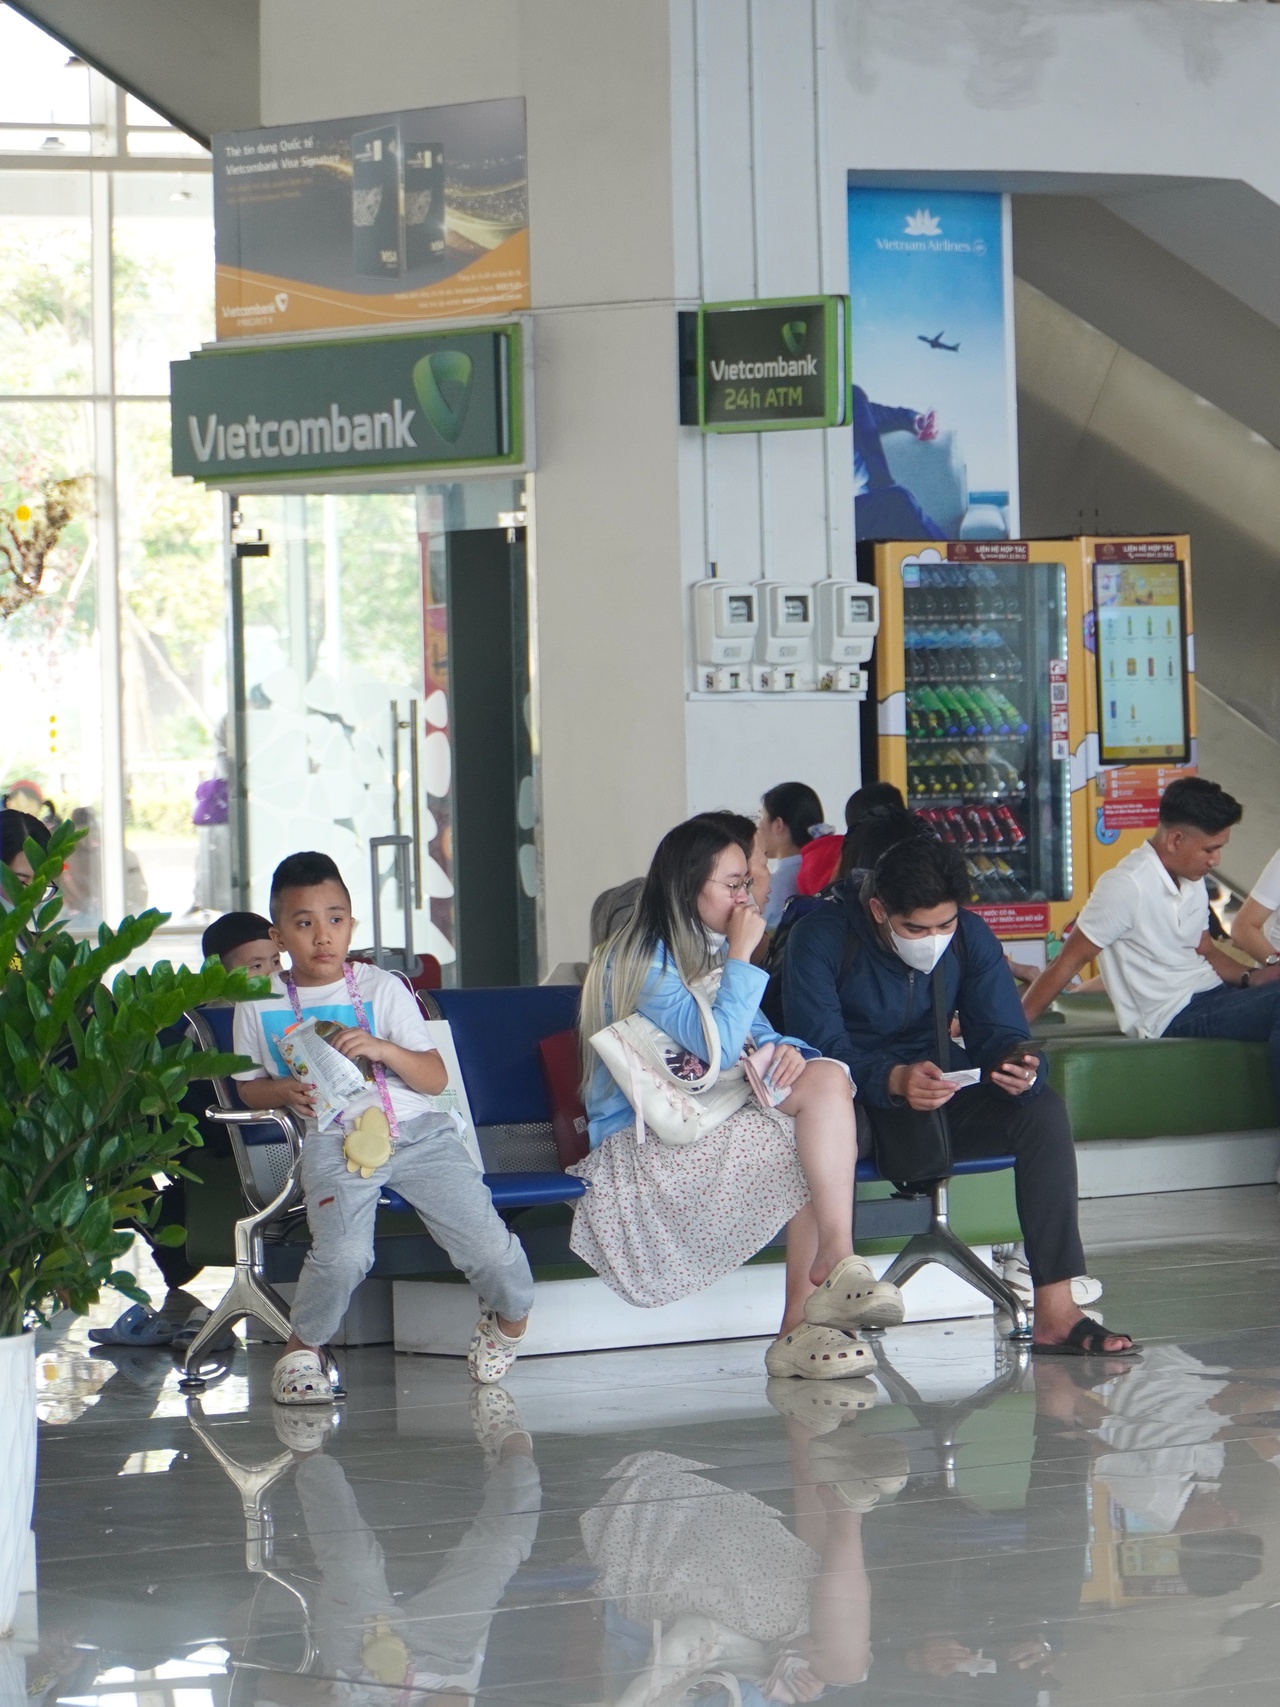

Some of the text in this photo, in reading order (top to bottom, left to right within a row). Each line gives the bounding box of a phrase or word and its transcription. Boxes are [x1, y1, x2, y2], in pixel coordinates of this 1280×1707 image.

[225, 154, 340, 175] Vietcombank Visa Signature
[876, 238, 970, 252] Vietnam Airlines
[221, 302, 276, 318] Vietcombank
[711, 354, 817, 381] Vietcombank
[724, 386, 802, 410] 24h ATM
[188, 398, 418, 462] Vietcombank
